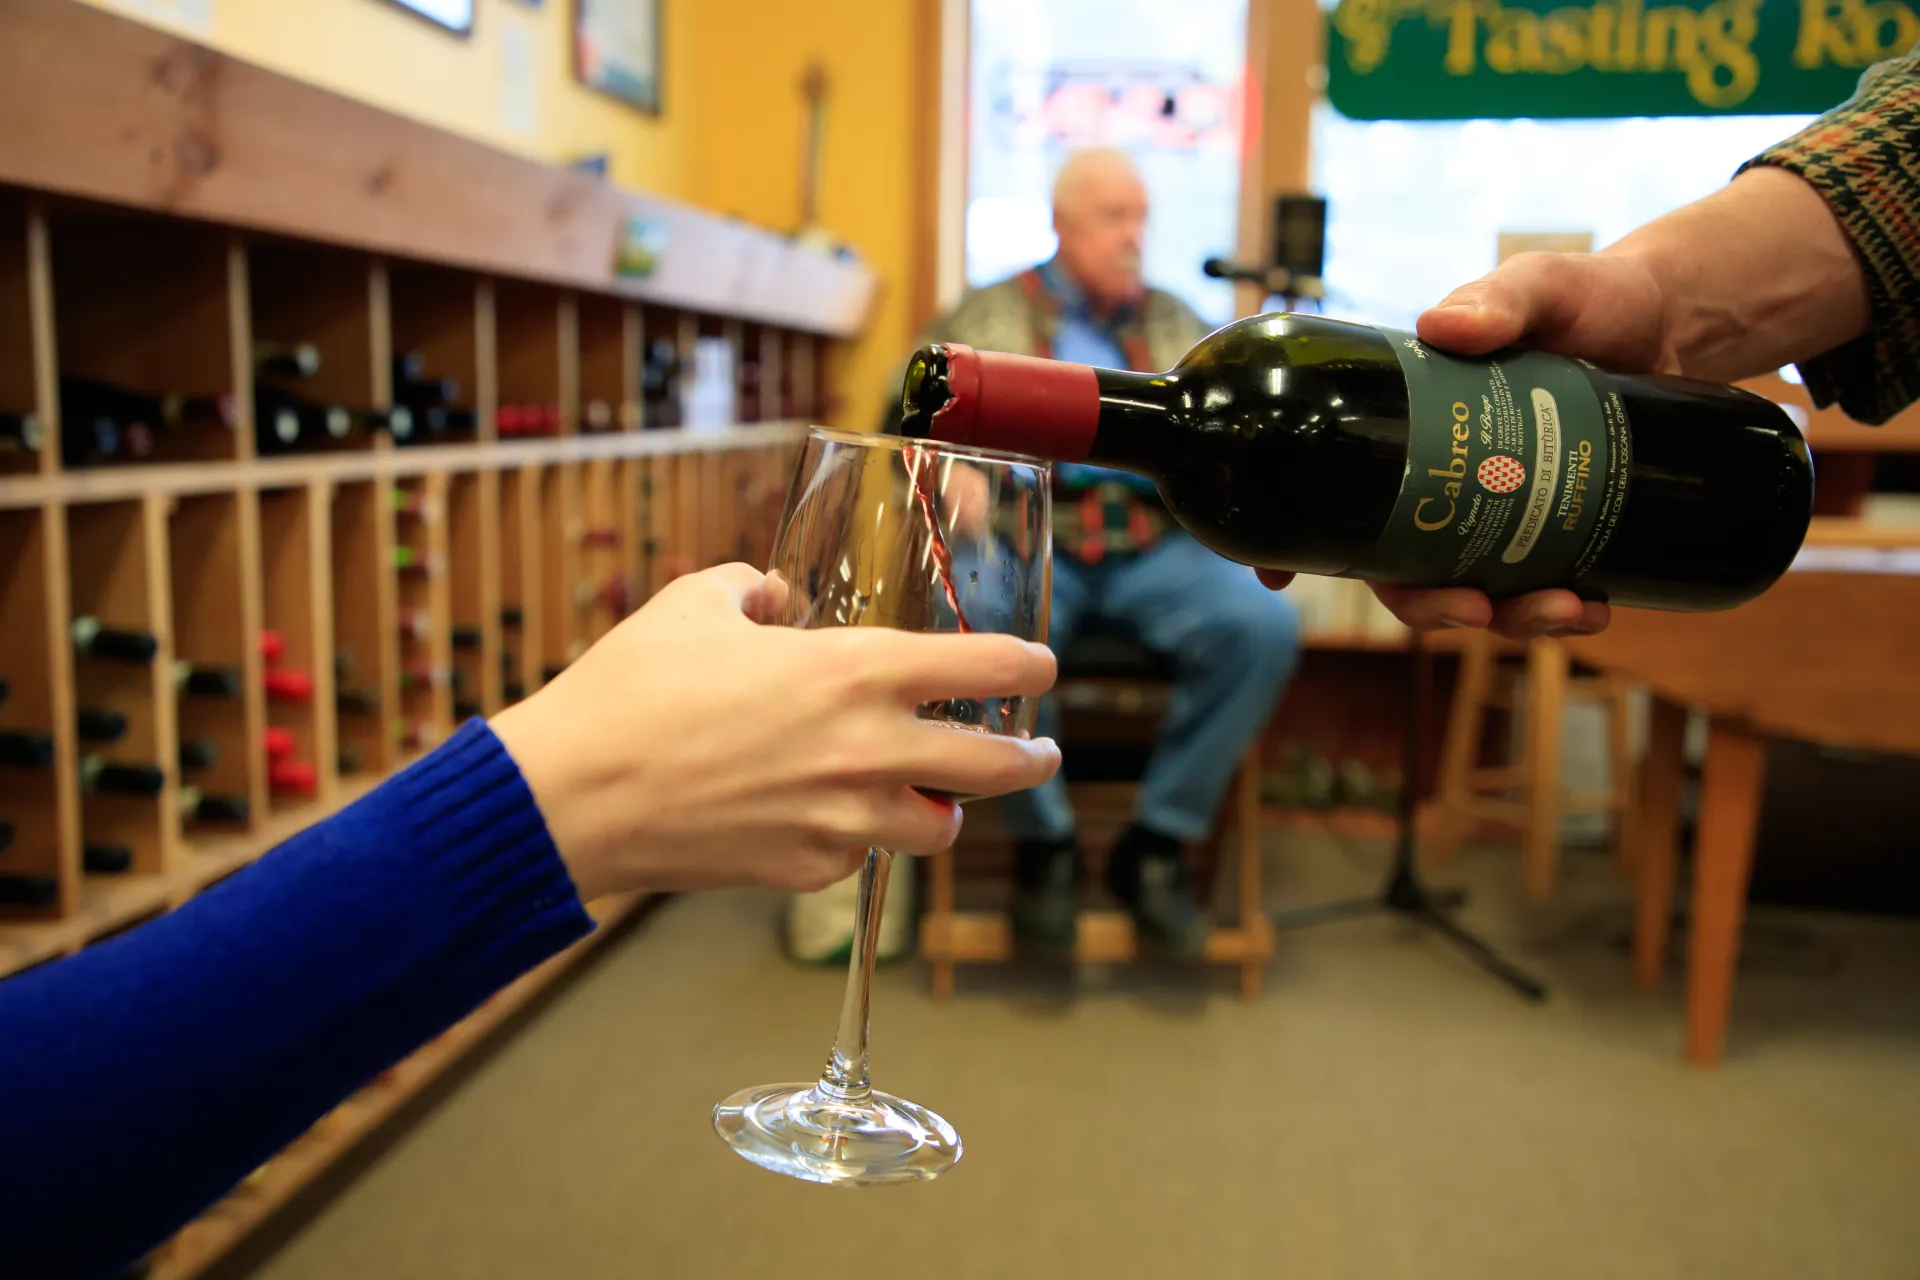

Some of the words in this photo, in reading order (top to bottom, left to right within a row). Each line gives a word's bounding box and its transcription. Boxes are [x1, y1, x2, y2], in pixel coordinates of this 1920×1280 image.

[1430, 0, 1759, 108] Tasting
[1498, 388, 1505, 396] IN
[1505, 391, 1515, 415] ROVERE
[1479, 394, 1495, 433] Borgo
[1496, 407, 1502, 416] IN
[1500, 396, 1510, 446] INVECCHIATO
[1510, 414, 1517, 424] DI
[1608, 391, 1625, 424] CENTRALE
[1480, 430, 1493, 450] Il
[1497, 440, 1503, 449] DI
[1517, 446, 1524, 456] IN
[1620, 425, 1629, 465] TOSCANA
[1413, 400, 1470, 531] Cabreo
[1618, 467, 1628, 490] DELLA
[1557, 450, 1578, 518] TENIMENTI
[1562, 440, 1592, 531] RUFFINO
[1457, 493, 1482, 535] Vigneto
[1480, 498, 1493, 521] NASCE
[1500, 498, 1515, 528] COMUNE
[1517, 487, 1549, 548] PREDICATO
[1540, 468, 1552, 482] DI
[1612, 491, 1624, 513] COLLI
[1481, 506, 1498, 535] VIGNETO
[1607, 515, 1618, 527] DEI
